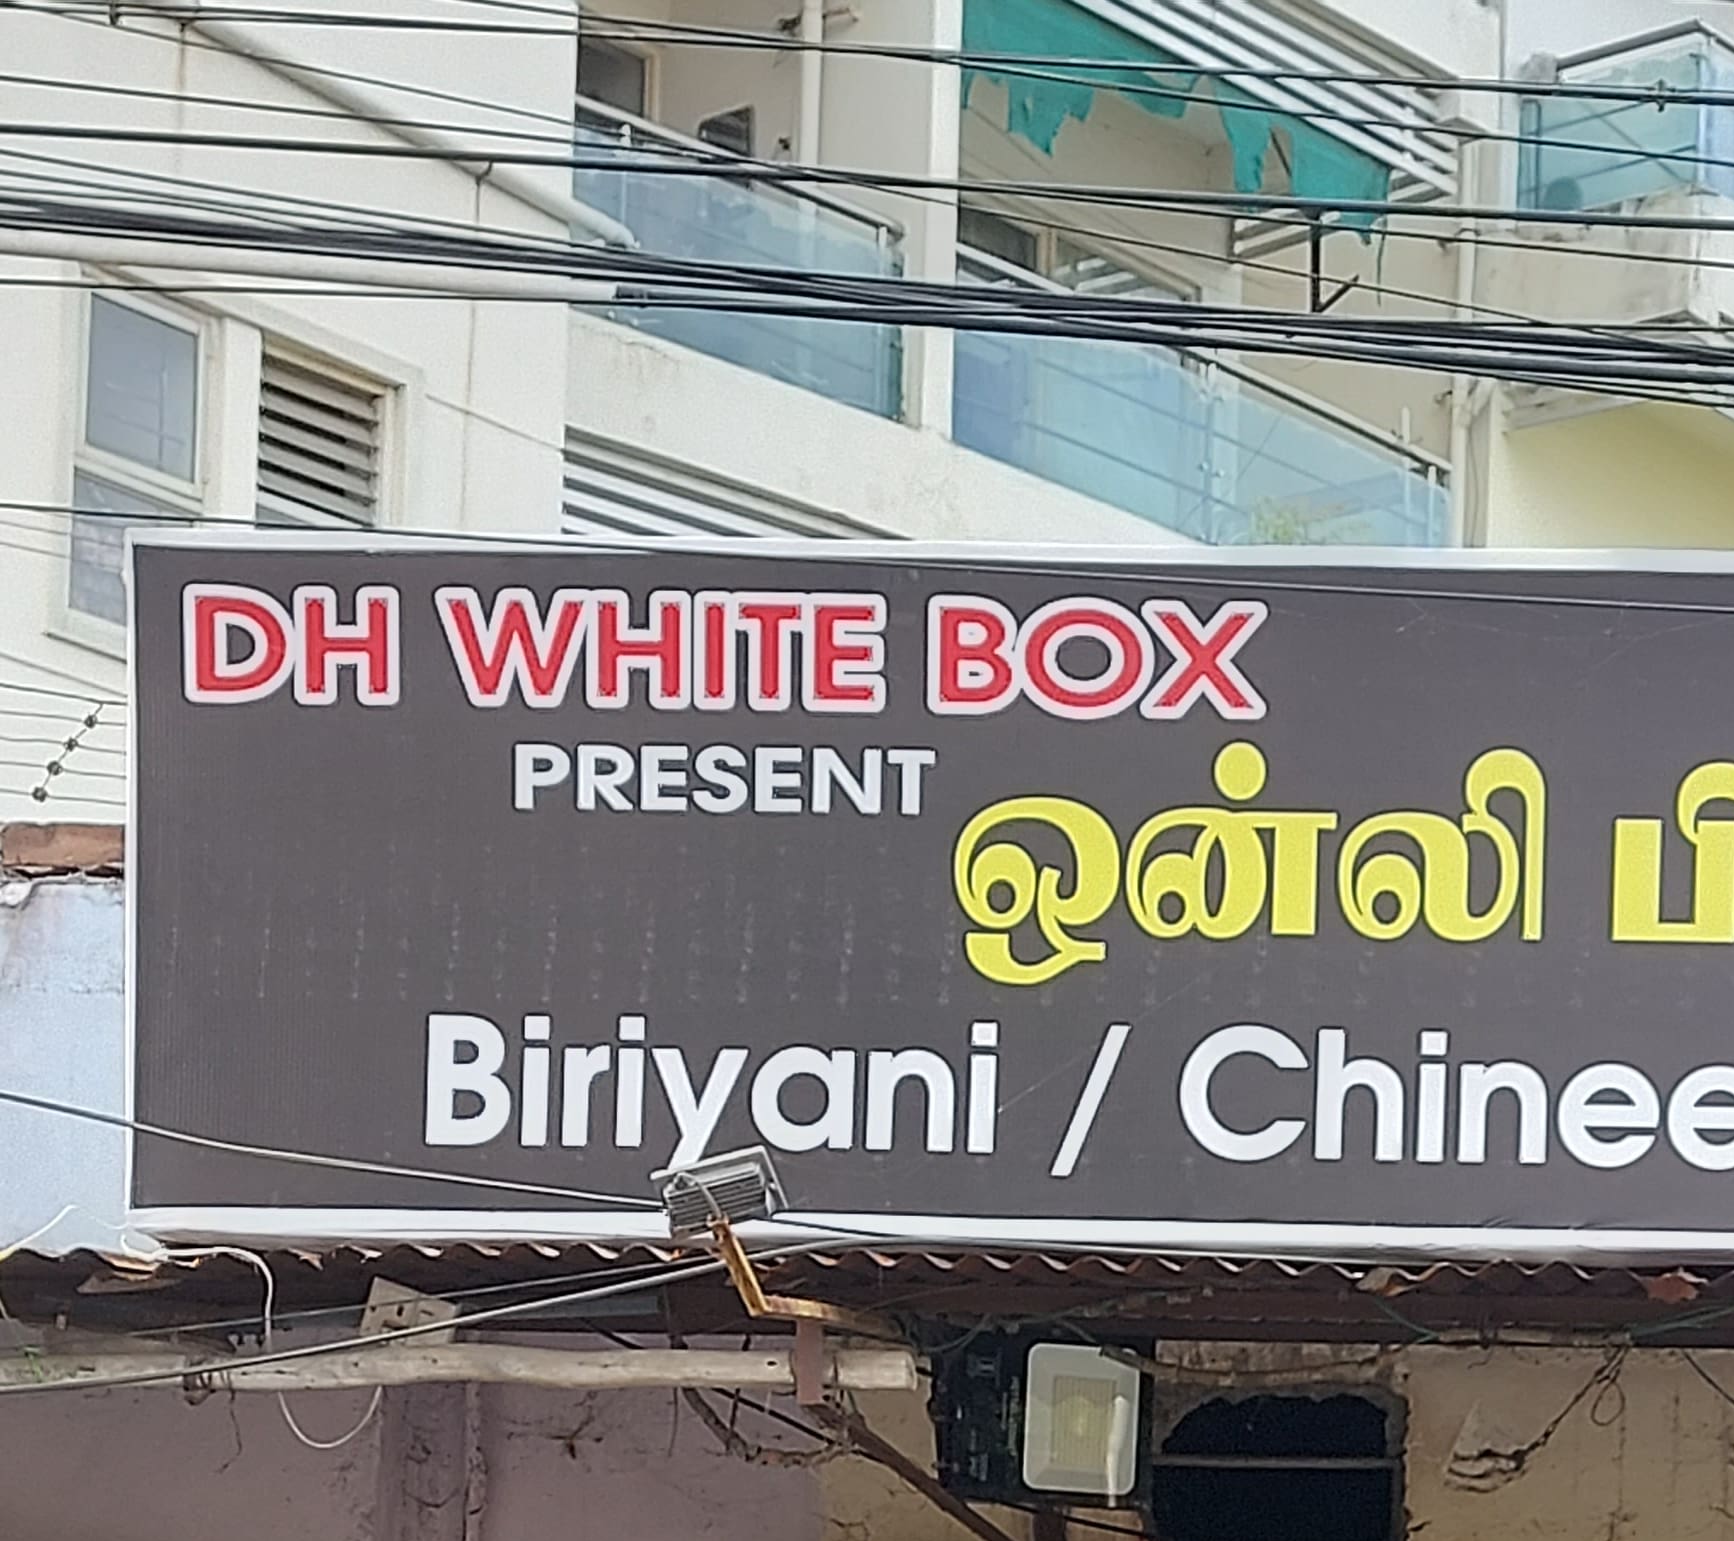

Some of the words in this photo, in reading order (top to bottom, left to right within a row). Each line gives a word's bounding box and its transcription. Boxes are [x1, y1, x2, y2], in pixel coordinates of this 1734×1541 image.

[184, 582, 400, 703] DH
[436, 586, 886, 714] WHITE
[926, 596, 1268, 720] BOX
[513, 744, 938, 817] PRESENT
[952, 740, 1548, 986] ஒன்லி
[425, 1012, 999, 1167] Biriyani
